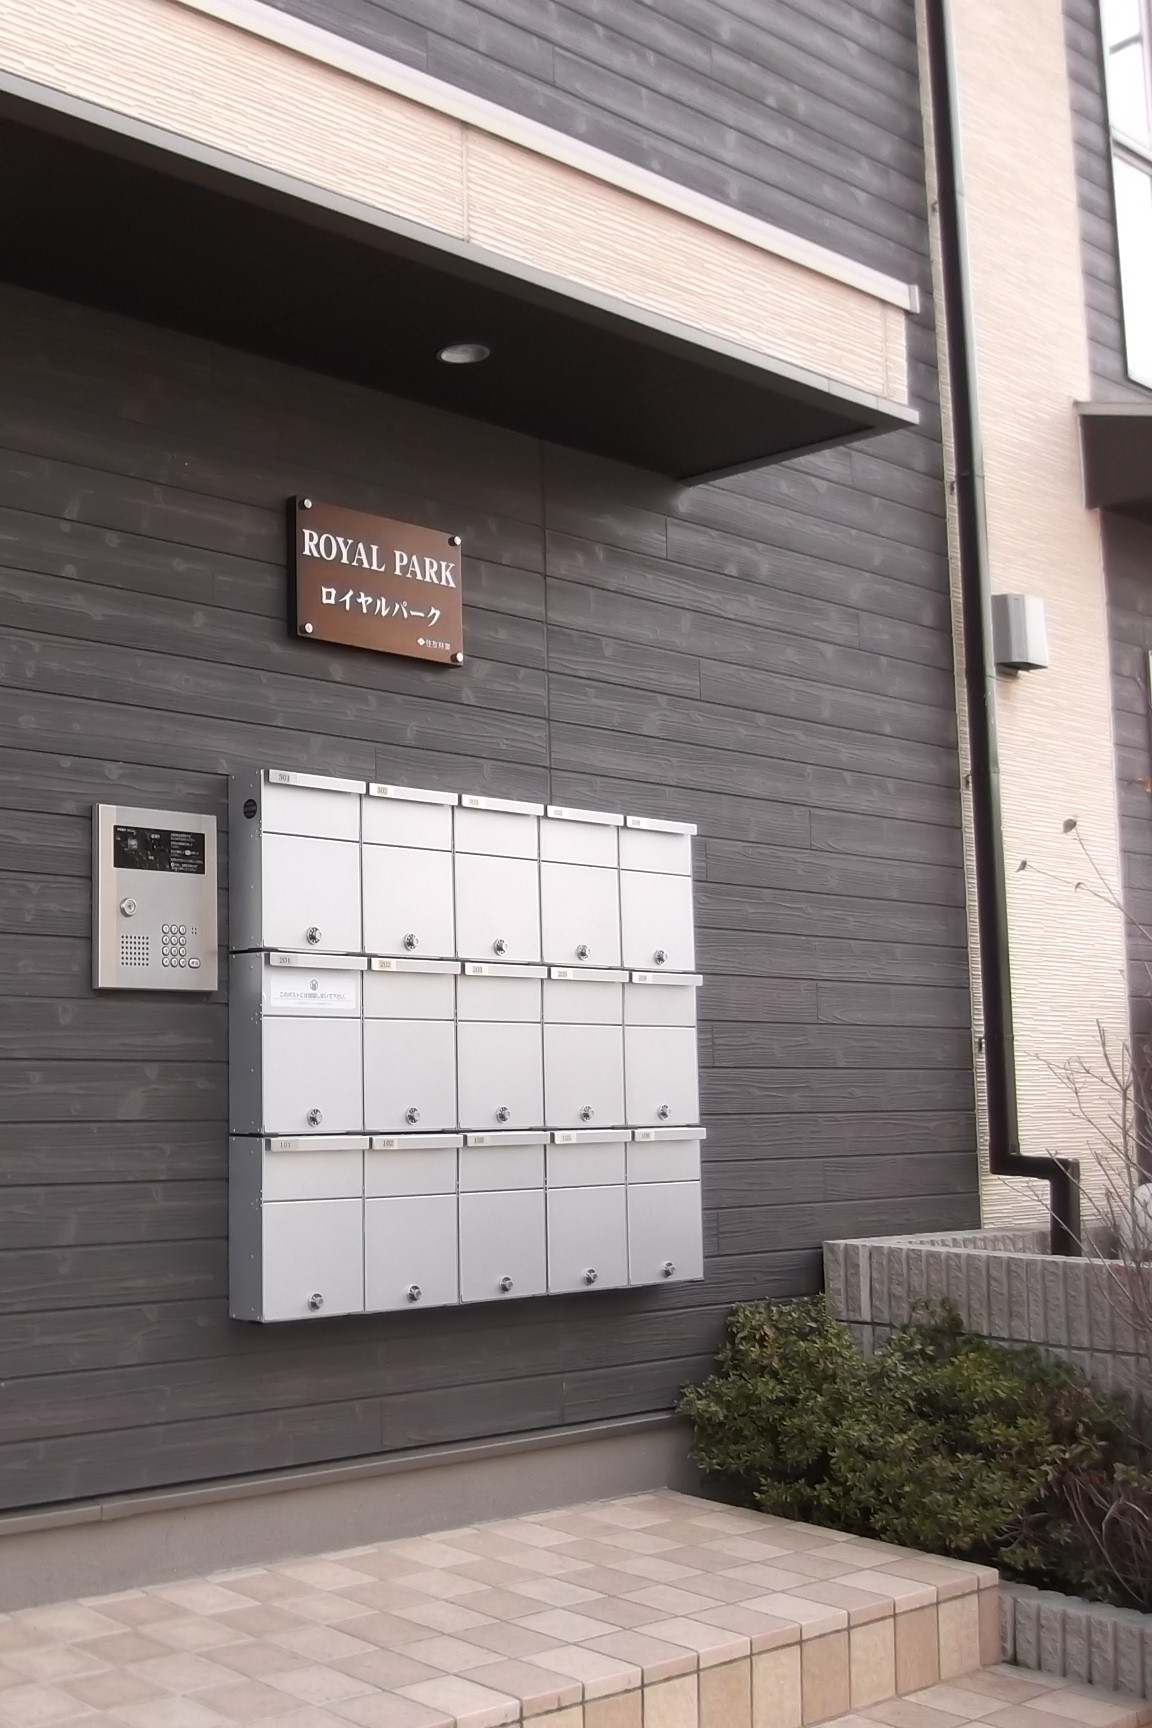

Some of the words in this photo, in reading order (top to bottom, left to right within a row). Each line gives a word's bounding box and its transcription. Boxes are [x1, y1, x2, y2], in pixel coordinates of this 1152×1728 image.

[302, 528, 386, 572] ROYAL
[393, 549, 457, 588] PARK
[321, 586, 441, 628] ロイヤルパーク
[278, 773, 290, 782] 301
[279, 956, 290, 965] 201
[379, 960, 391, 969] 202
[280, 1141, 291, 1149] 101
[383, 1139, 394, 1147] 102
